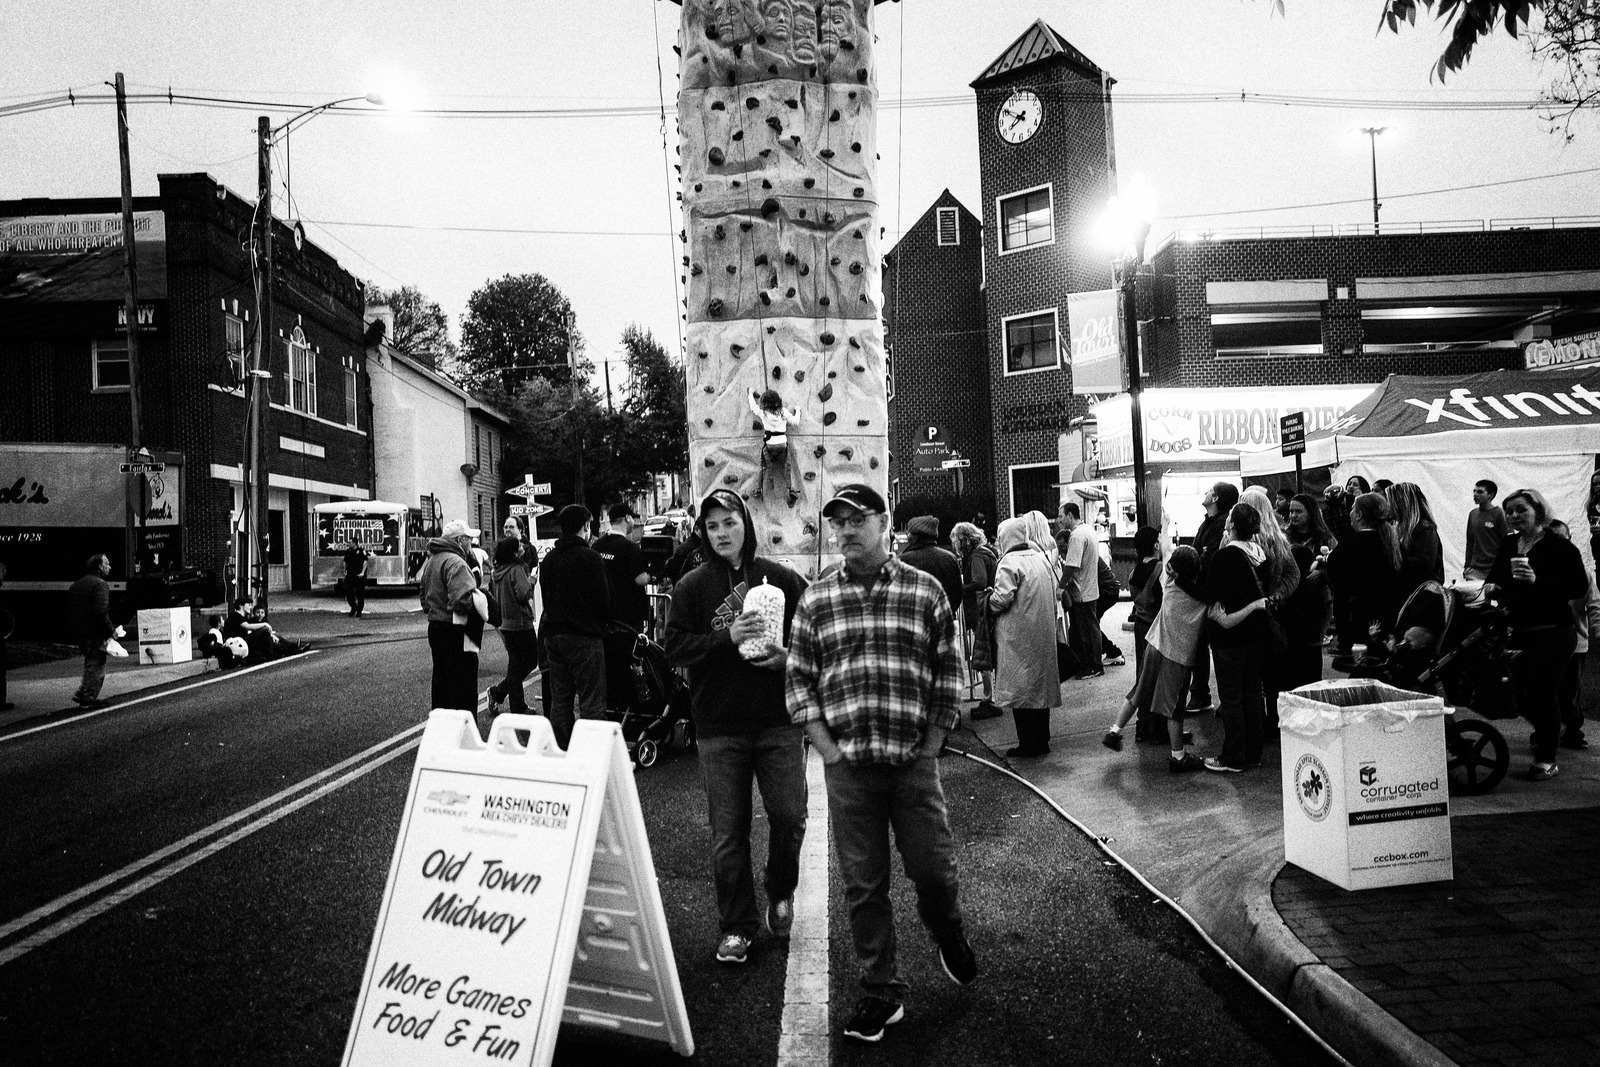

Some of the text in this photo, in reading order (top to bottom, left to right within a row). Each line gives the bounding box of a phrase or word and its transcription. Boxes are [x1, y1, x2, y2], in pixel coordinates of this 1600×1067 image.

[11, 222, 54, 237] LIBERTY
[58, 220, 79, 235] AND
[82, 219, 101, 234] THE
[105, 217, 151, 232] PUUIT
[16, 237, 34, 252] ALL
[37, 236, 61, 250] WHO
[65, 234, 118, 250] THREATEN
[118, 309, 154, 324] NVY
[1081, 315, 1113, 341] Old
[1072, 335, 1115, 359] Town
[1554, 336, 1573, 347] FRESH
[1525, 339, 1600, 368] LEMON
[1148, 406, 1194, 421] CORN
[928, 426, 938, 440] P
[1198, 408, 1279, 446] RIBBON
[915, 445, 950, 455] Auto Park
[1148, 437, 1193, 454] DOGS
[515, 486, 549, 496] CONCERT
[333, 519, 371, 530] NATIONAL
[17, 532, 42, 542] 1928
[333, 528, 385, 545] GUARD
[1360, 777, 1439, 797] corrugated
[484, 795, 571, 817] WASHINGTON
[1365, 794, 1398, 803] container
[481, 809, 567, 830] AREA CHEVY DEALERS
[1380, 809, 1414, 818] creativity
[1415, 806, 1442, 815] unfolds
[1373, 850, 1429, 863] cccbox.com
[421, 849, 542, 895] Old Town
[422, 891, 527, 946] Midway
[378, 961, 532, 1019] More Games
[372, 1002, 521, 1062] Food & Fun
